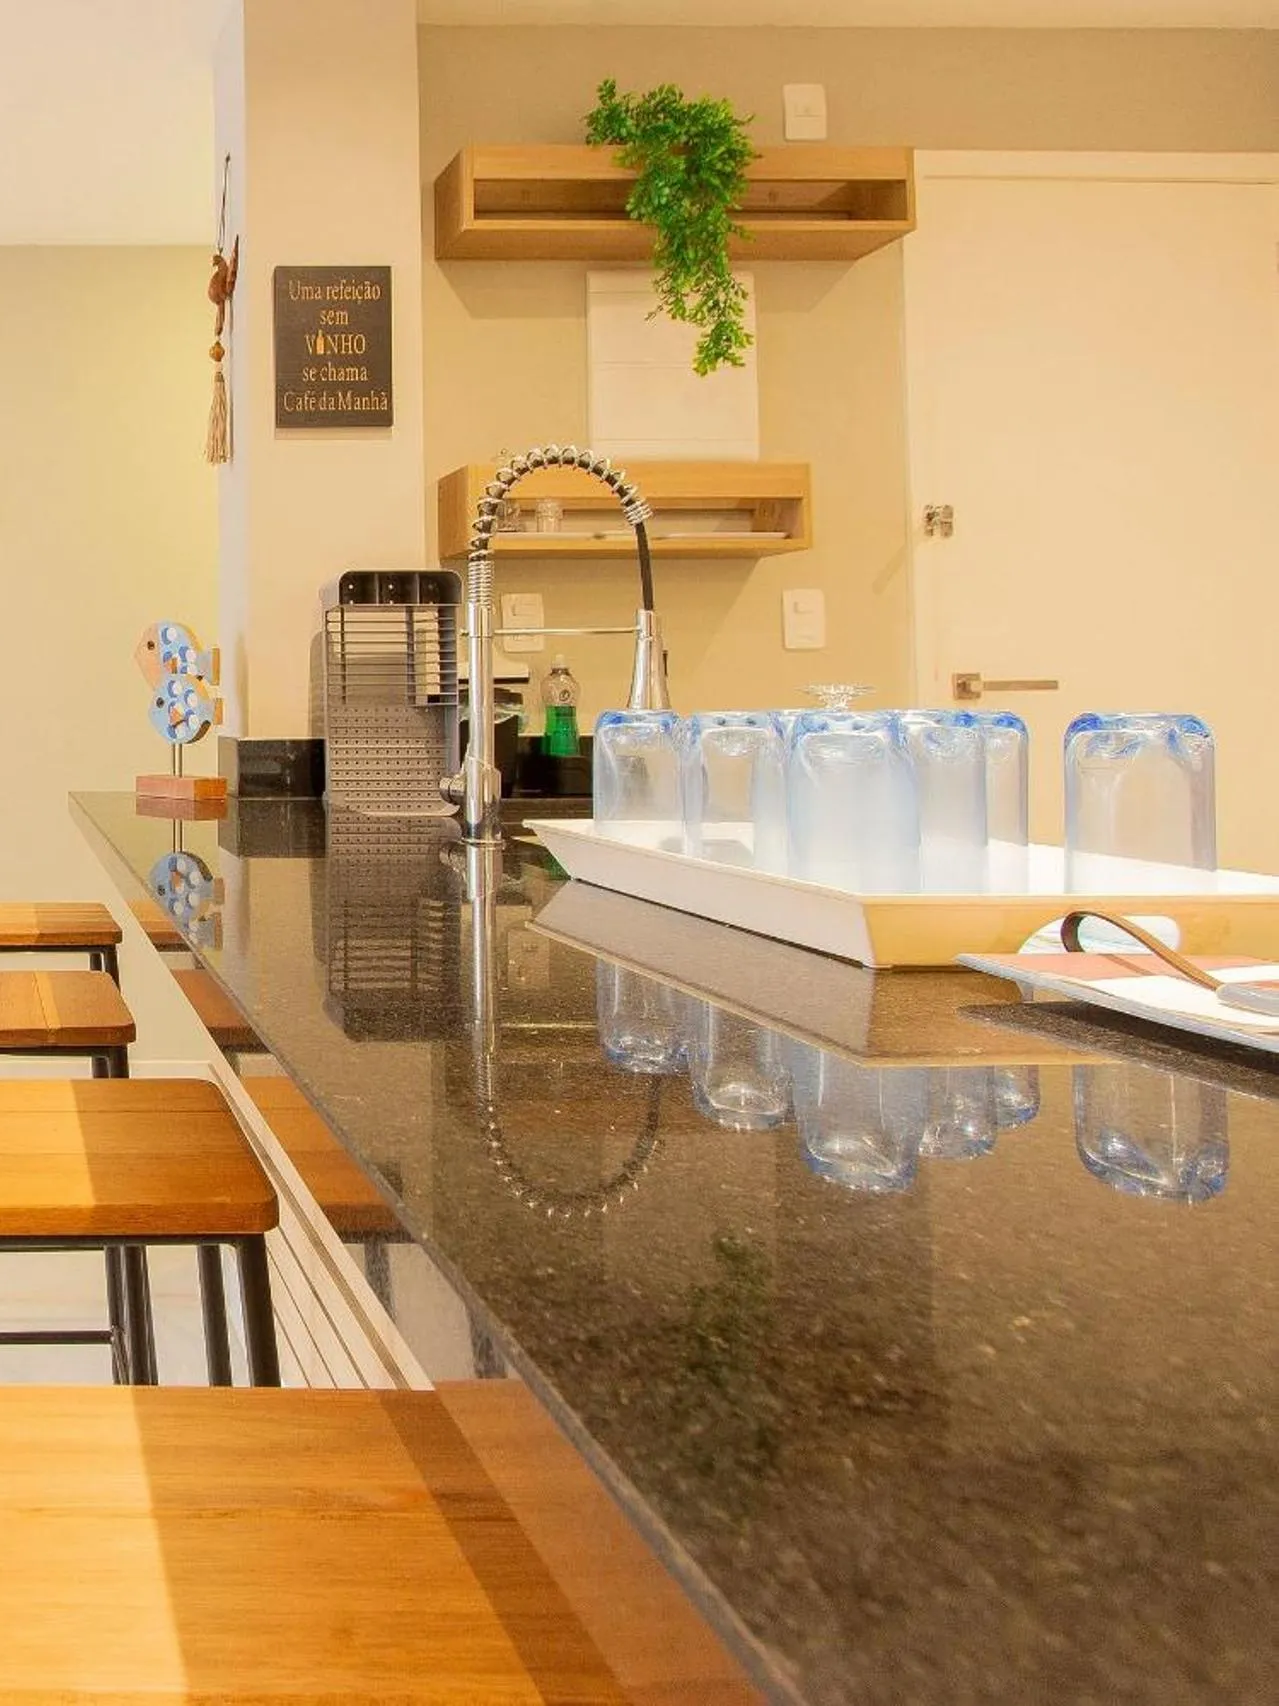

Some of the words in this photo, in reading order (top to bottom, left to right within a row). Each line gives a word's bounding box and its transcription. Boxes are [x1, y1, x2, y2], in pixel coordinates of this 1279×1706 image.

[288, 280, 321, 300] Uma
[326, 280, 381, 304] refeição
[320, 309, 349, 325] sem
[302, 367, 318, 381] se
[319, 362, 368, 381] chama
[283, 390, 317, 412] Café
[319, 391, 336, 411] da
[337, 390, 388, 411] Manhã
